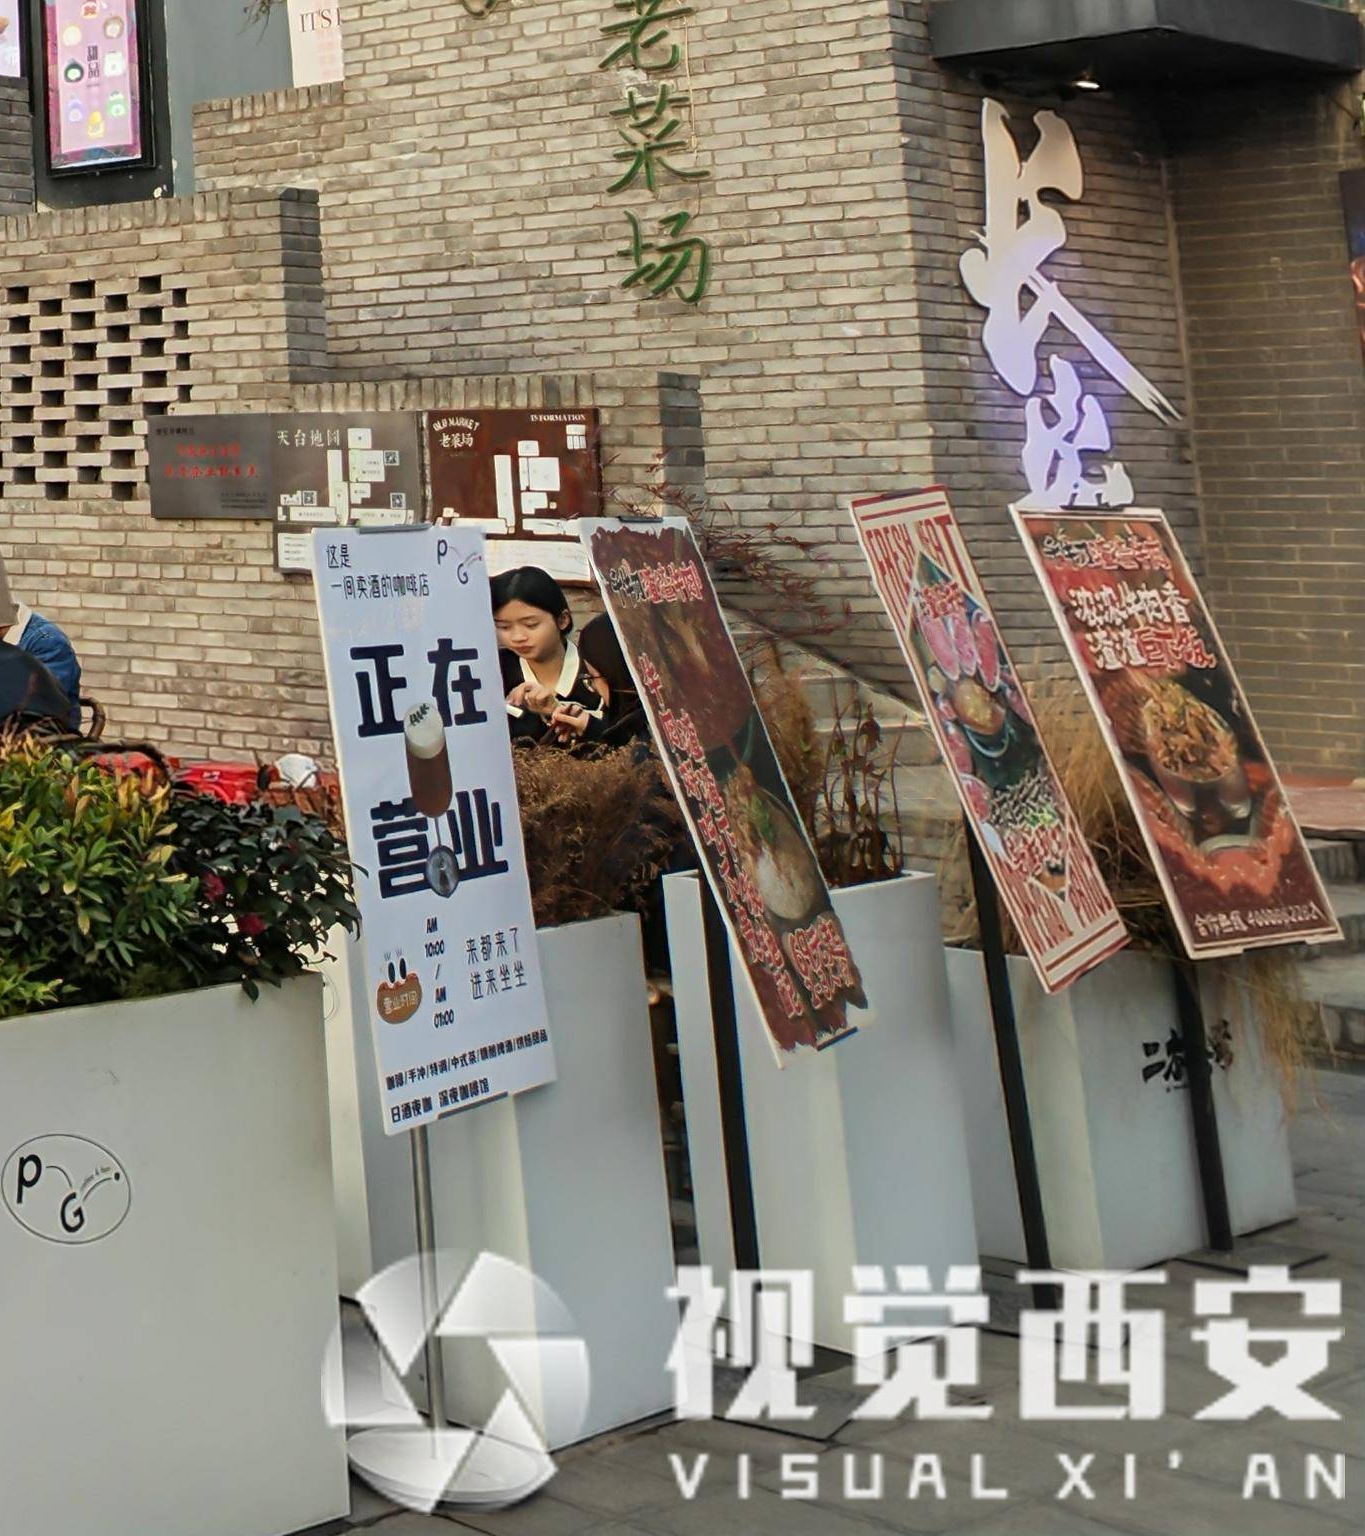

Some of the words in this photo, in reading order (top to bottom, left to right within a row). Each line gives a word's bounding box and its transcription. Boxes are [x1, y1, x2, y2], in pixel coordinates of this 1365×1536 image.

[530, 413, 586, 423] INFORMATION
[276, 428, 341, 448] 天台地图
[438, 433, 474, 449] 老菜场
[326, 544, 352, 569] 这是
[330, 573, 430, 600] 一间卖酒的咖啡店
[350, 638, 488, 738] 正在
[370, 786, 510, 900] 营业
[426, 917, 438, 934] AM
[425, 940, 445, 958] 10:00
[466, 927, 519, 964] 来都来了
[470, 960, 528, 1000] 进来坐坐
[435, 987, 447, 1004] AM
